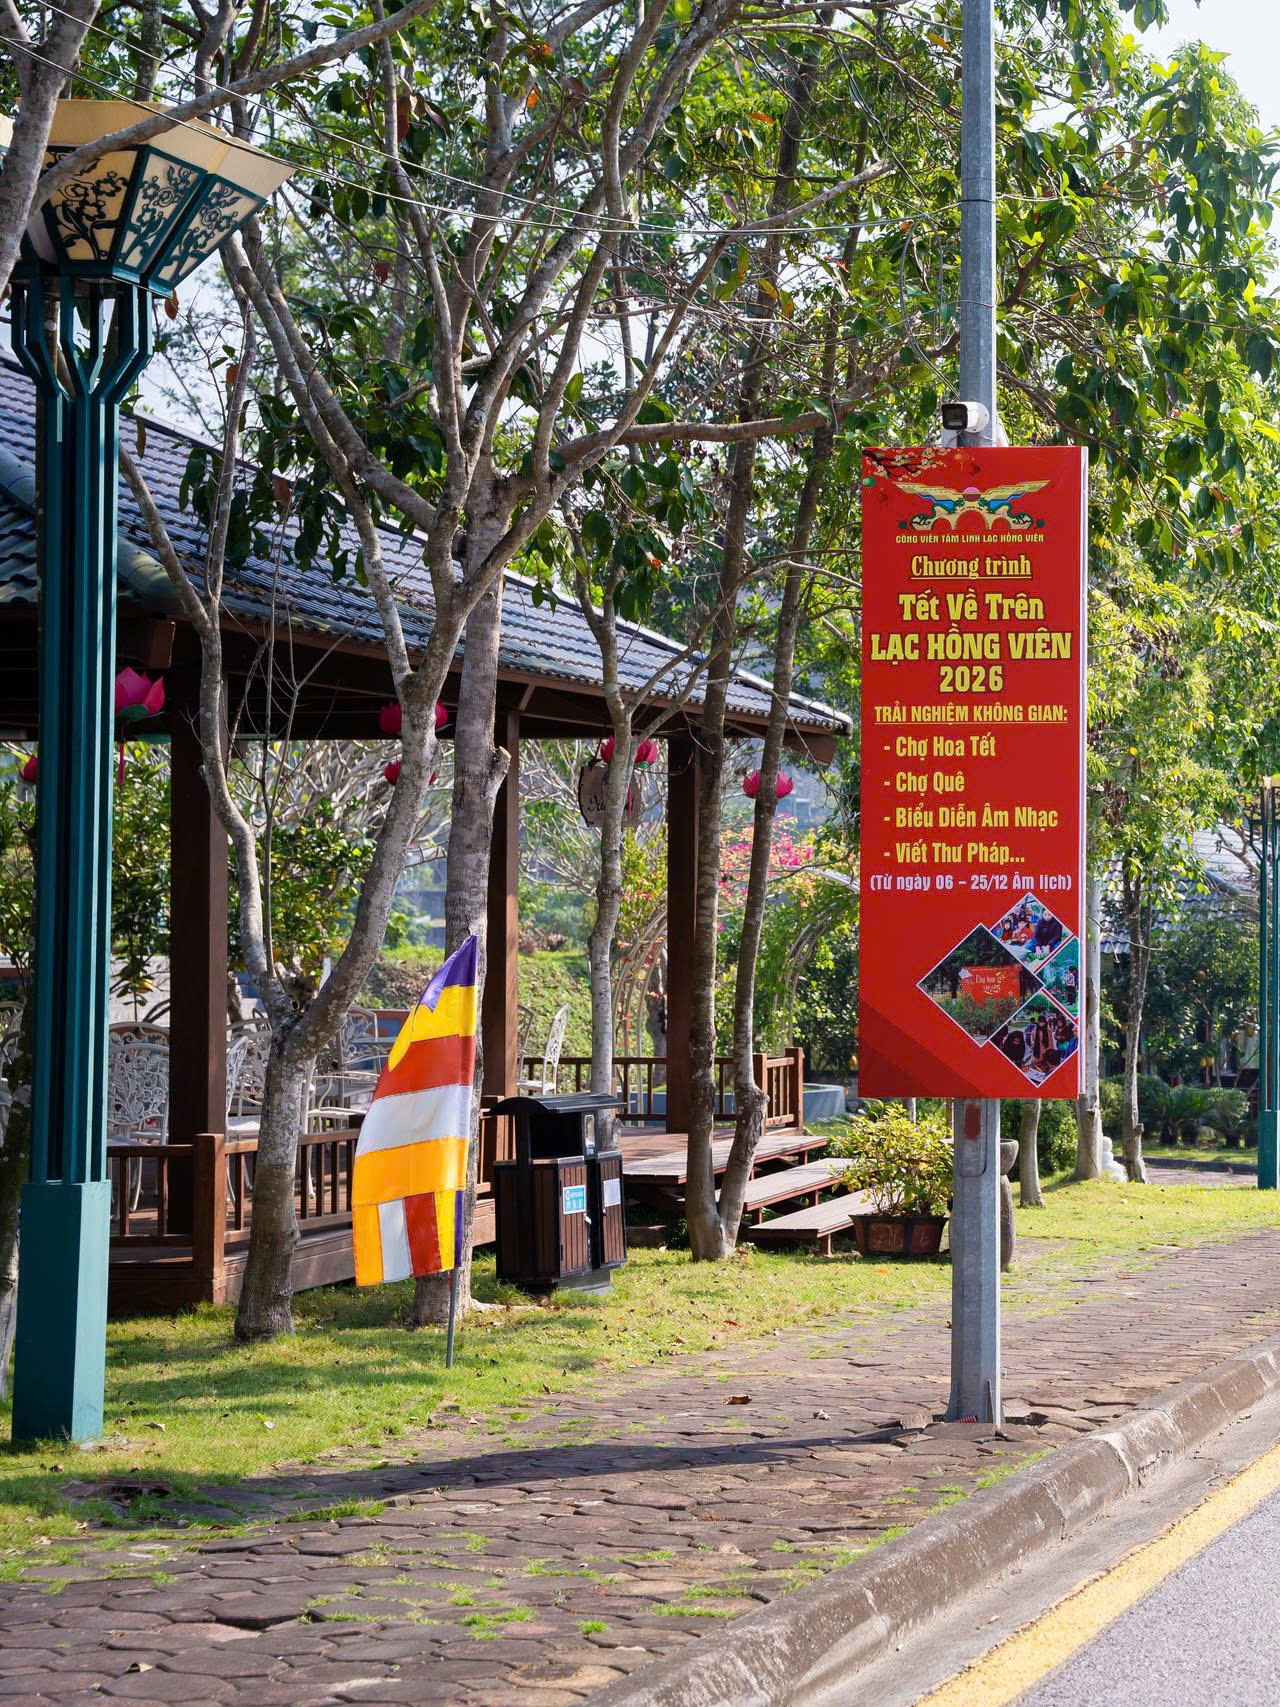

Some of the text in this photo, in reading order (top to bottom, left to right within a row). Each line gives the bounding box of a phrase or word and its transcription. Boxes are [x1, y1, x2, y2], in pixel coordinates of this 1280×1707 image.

[895, 532, 917, 544] CÔNG
[920, 532, 939, 544] VIÊN
[961, 534, 981, 543] LINH
[982, 534, 999, 545] LẠC
[1025, 532, 1044, 543] VIÊN
[910, 554, 1033, 580] Chương trình
[898, 587, 1045, 621] Tết Về Trên
[870, 622, 1072, 666] LẠC HỒNG VIÊN
[938, 665, 1004, 693] 2026
[874, 700, 1068, 725] TRẢI NGHIỆM KHÔNG GIAN:
[895, 735, 929, 761] Chợ
[932, 735, 965, 757] Hoa
[969, 731, 996, 757] Tết
[895, 771, 929, 797] Chợ
[932, 770, 965, 795] Quê
[895, 802, 934, 828] Biểu
[938, 803, 977, 828] Diễn
[981, 802, 1009, 828] Âm
[1014, 806, 1059, 832] Nhạc
[895, 838, 928, 864] Viết
[931, 842, 963, 864] Thư
[967, 841, 1025, 866] Pháp...
[870, 873, 893, 891] (Từ
[896, 873, 931, 892] ngày
[935, 874, 954, 890] 06
[970, 874, 1008, 892] 25/12
[1012, 871, 1036, 891] Âm
[1039, 874, 1072, 893] lịch)
